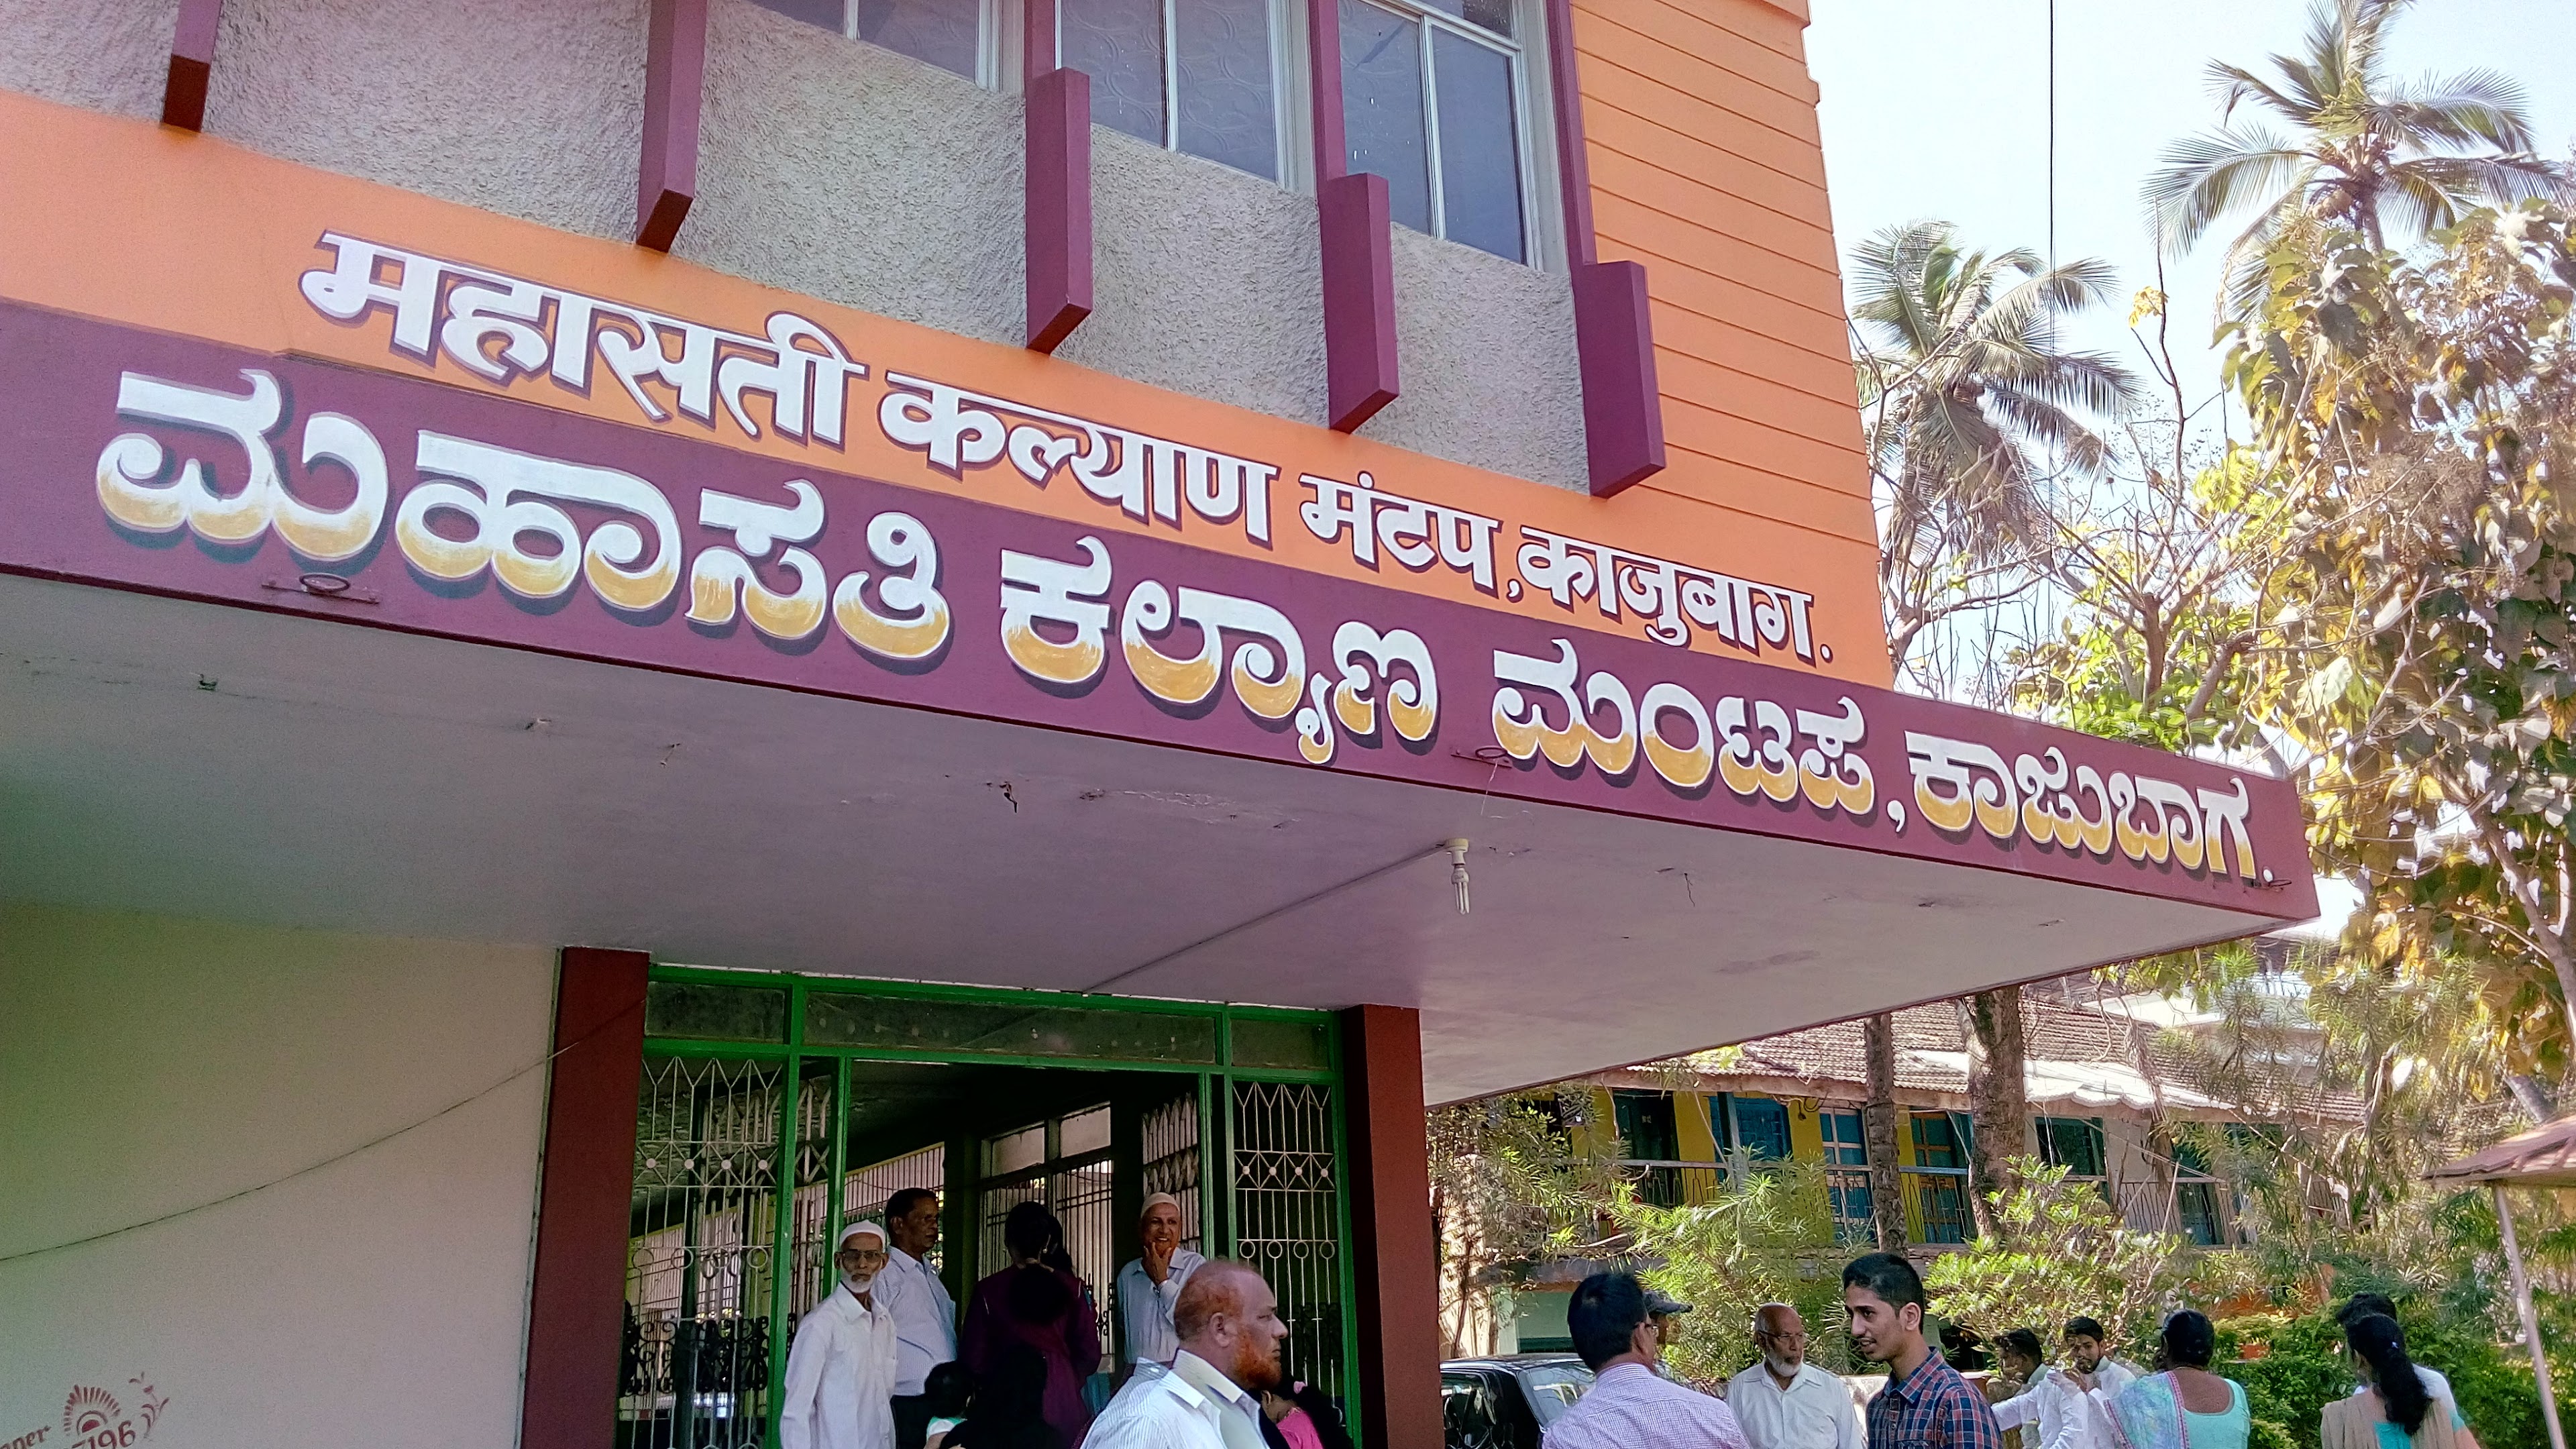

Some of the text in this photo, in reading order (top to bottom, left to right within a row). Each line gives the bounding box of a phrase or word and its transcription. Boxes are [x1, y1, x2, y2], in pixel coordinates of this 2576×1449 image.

[299, 229, 867, 440] महासती
[879, 372, 1278, 539] कल्याण
[95, 368, 951, 659] ಮಹಾಸತಿ
[999, 536, 1438, 765] ಕಲ್ಯಾಣ
